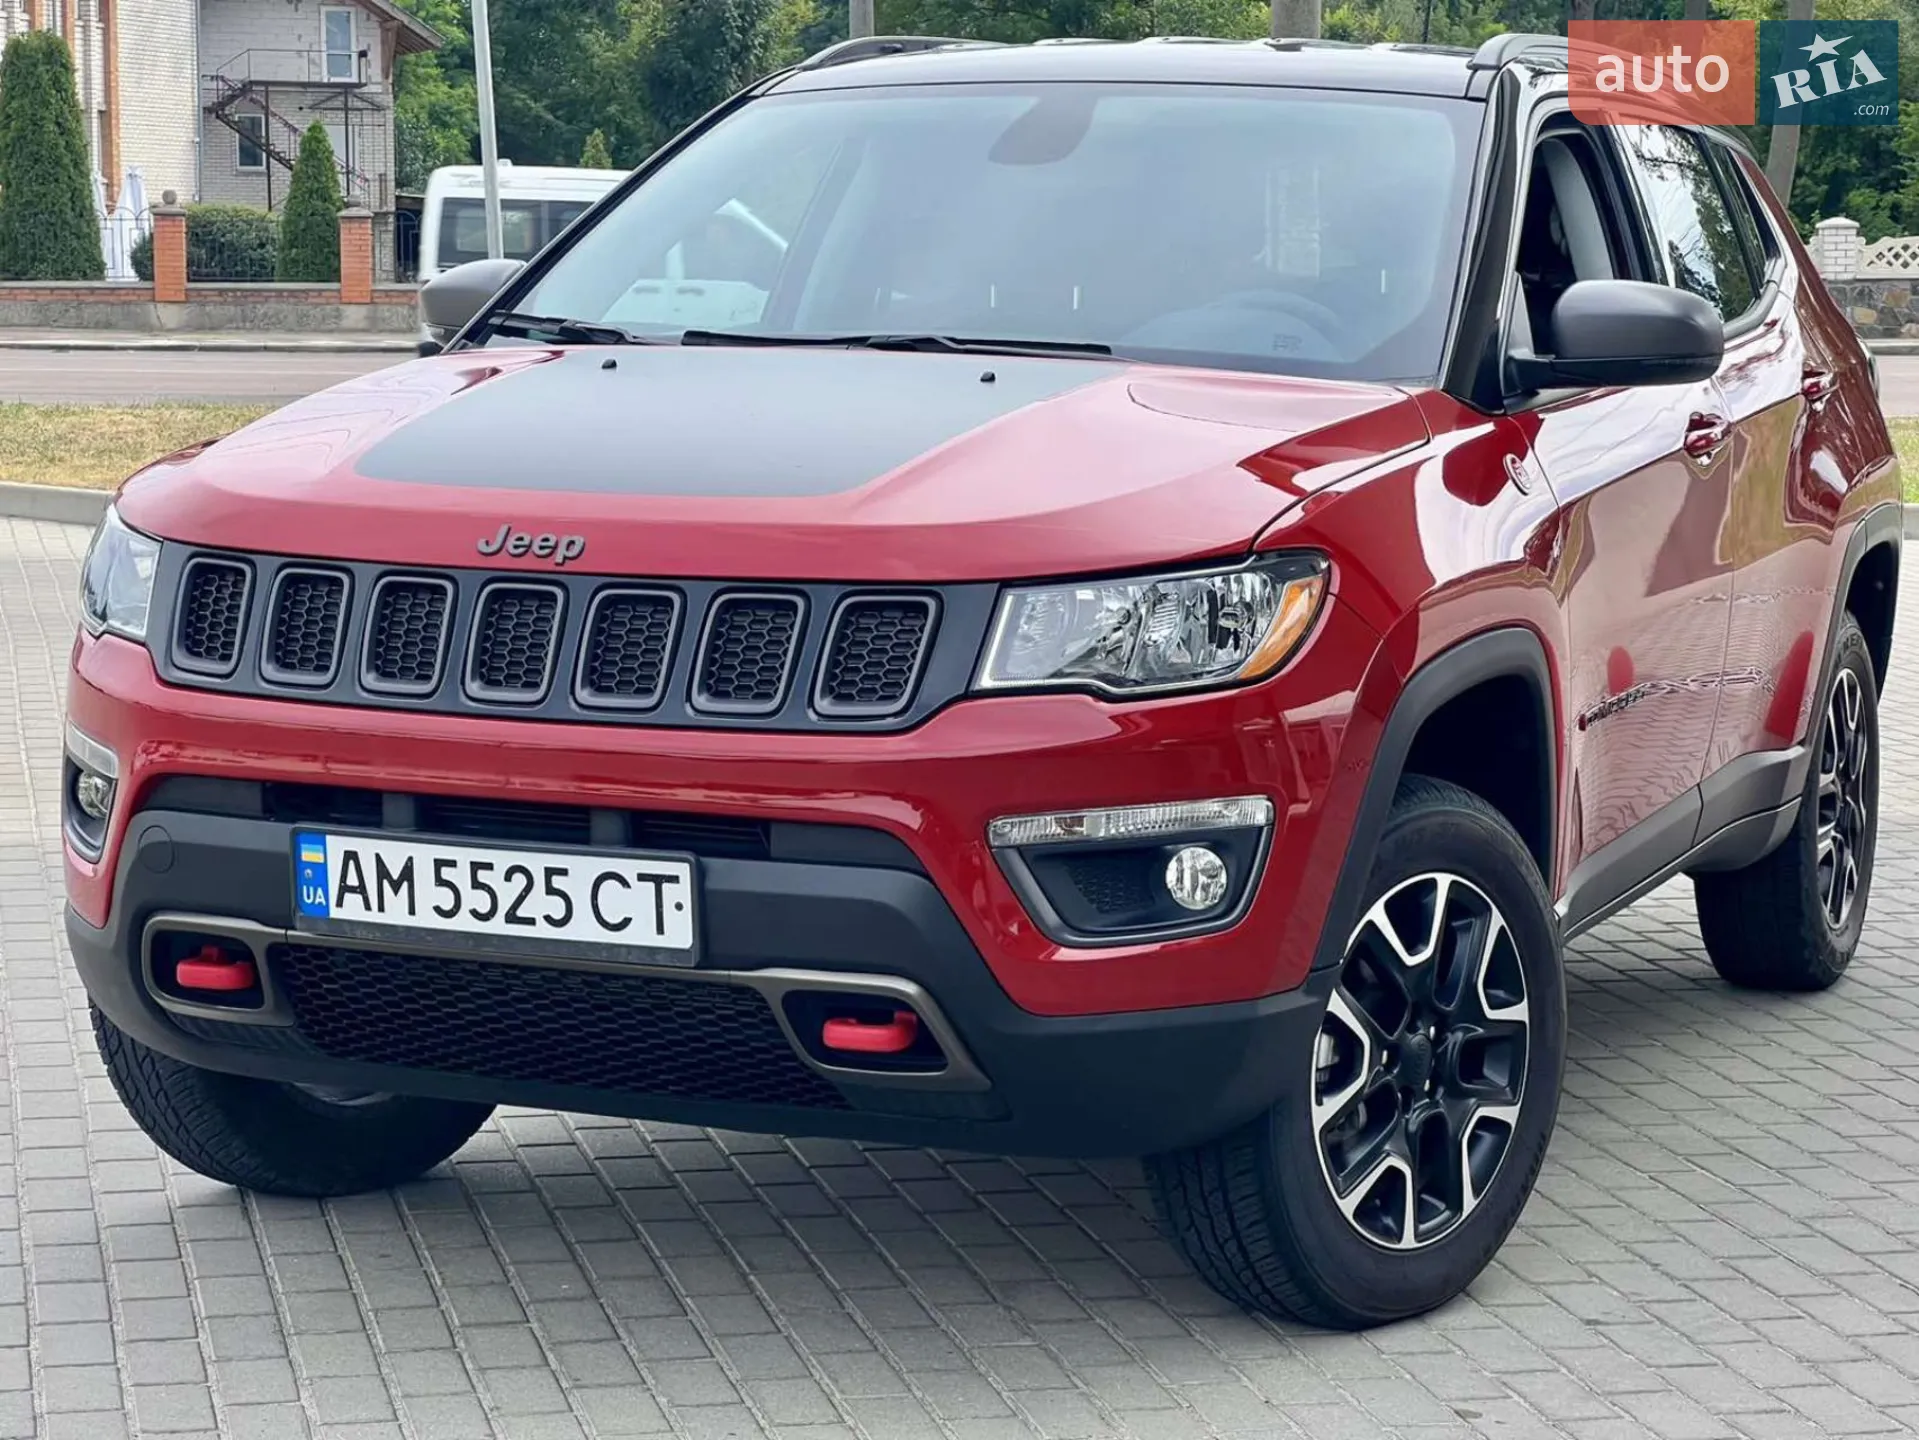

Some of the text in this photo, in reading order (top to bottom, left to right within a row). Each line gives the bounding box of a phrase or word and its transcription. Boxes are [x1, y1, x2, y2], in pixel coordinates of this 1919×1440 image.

[477, 522, 586, 566] Jeep
[303, 884, 327, 907] UA
[335, 850, 680, 936] AM 5525 CT
